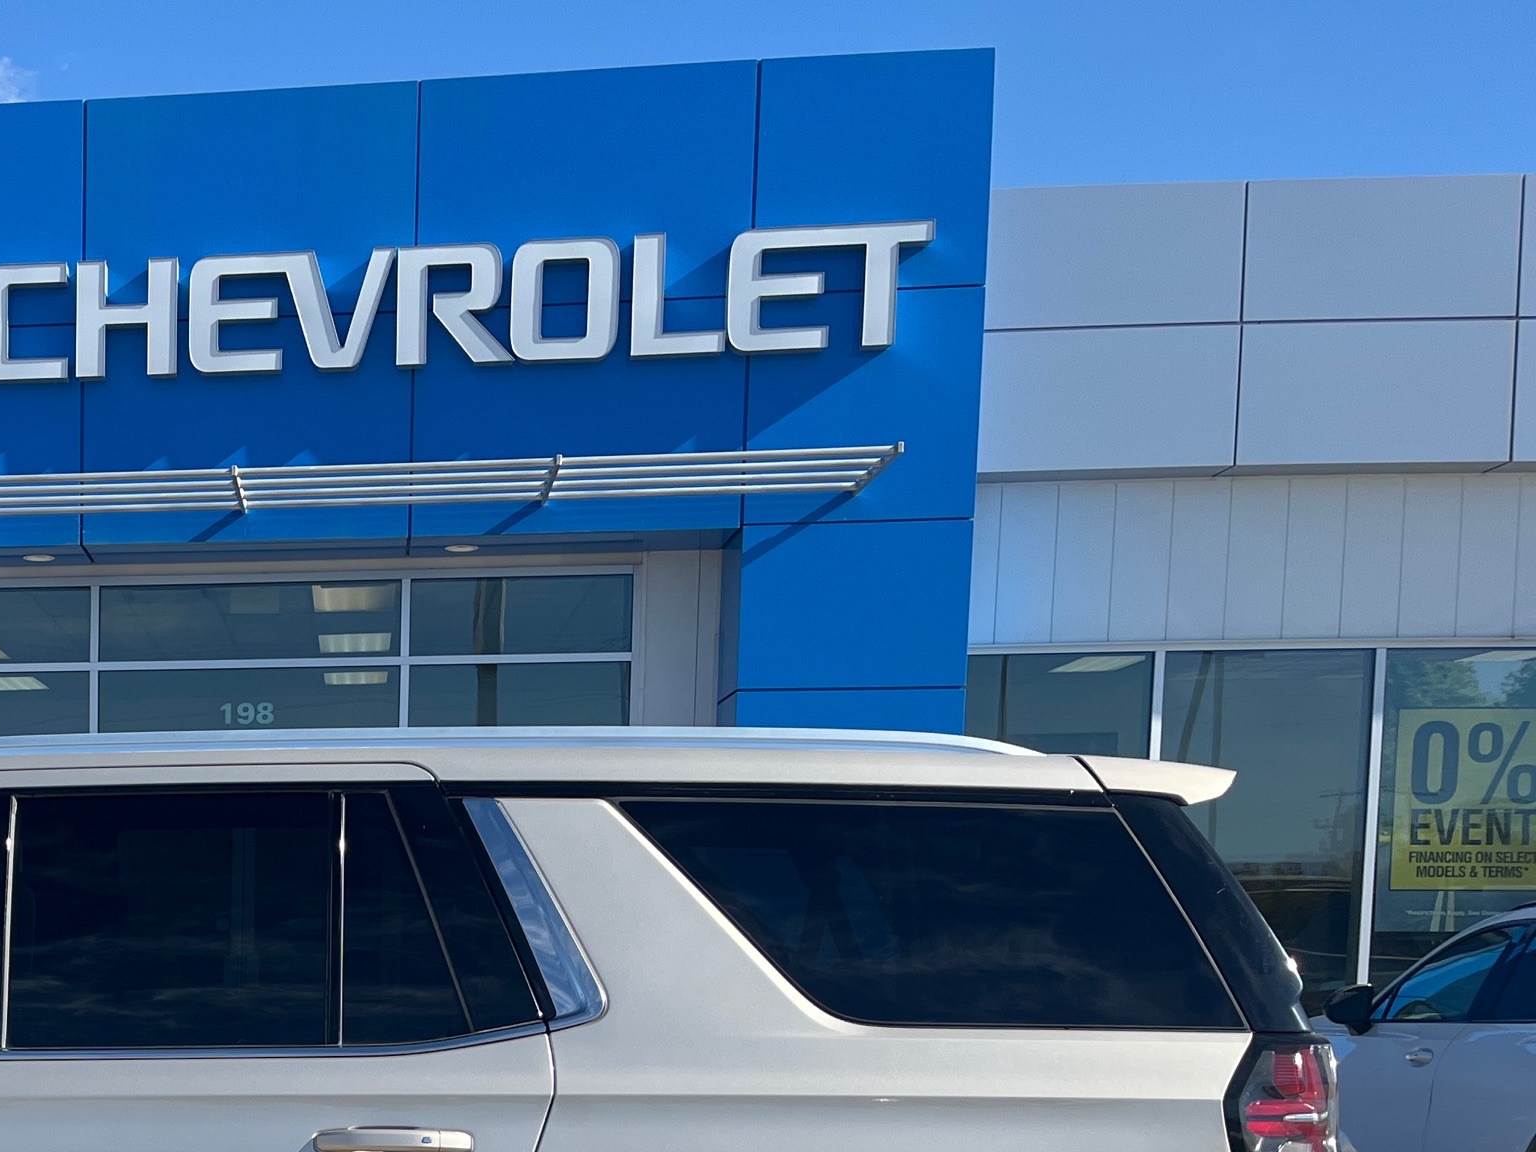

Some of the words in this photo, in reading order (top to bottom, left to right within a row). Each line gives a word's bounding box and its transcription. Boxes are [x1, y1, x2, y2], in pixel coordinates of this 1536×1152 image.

[220, 702, 275, 725] 198
[1410, 720, 1536, 805] 0%
[1409, 808, 1536, 846] EVENT
[1409, 851, 1472, 863] FINANCING
[1475, 852, 1492, 863] ON
[1416, 865, 1466, 877] MODELS
[1469, 866, 1478, 878] &
